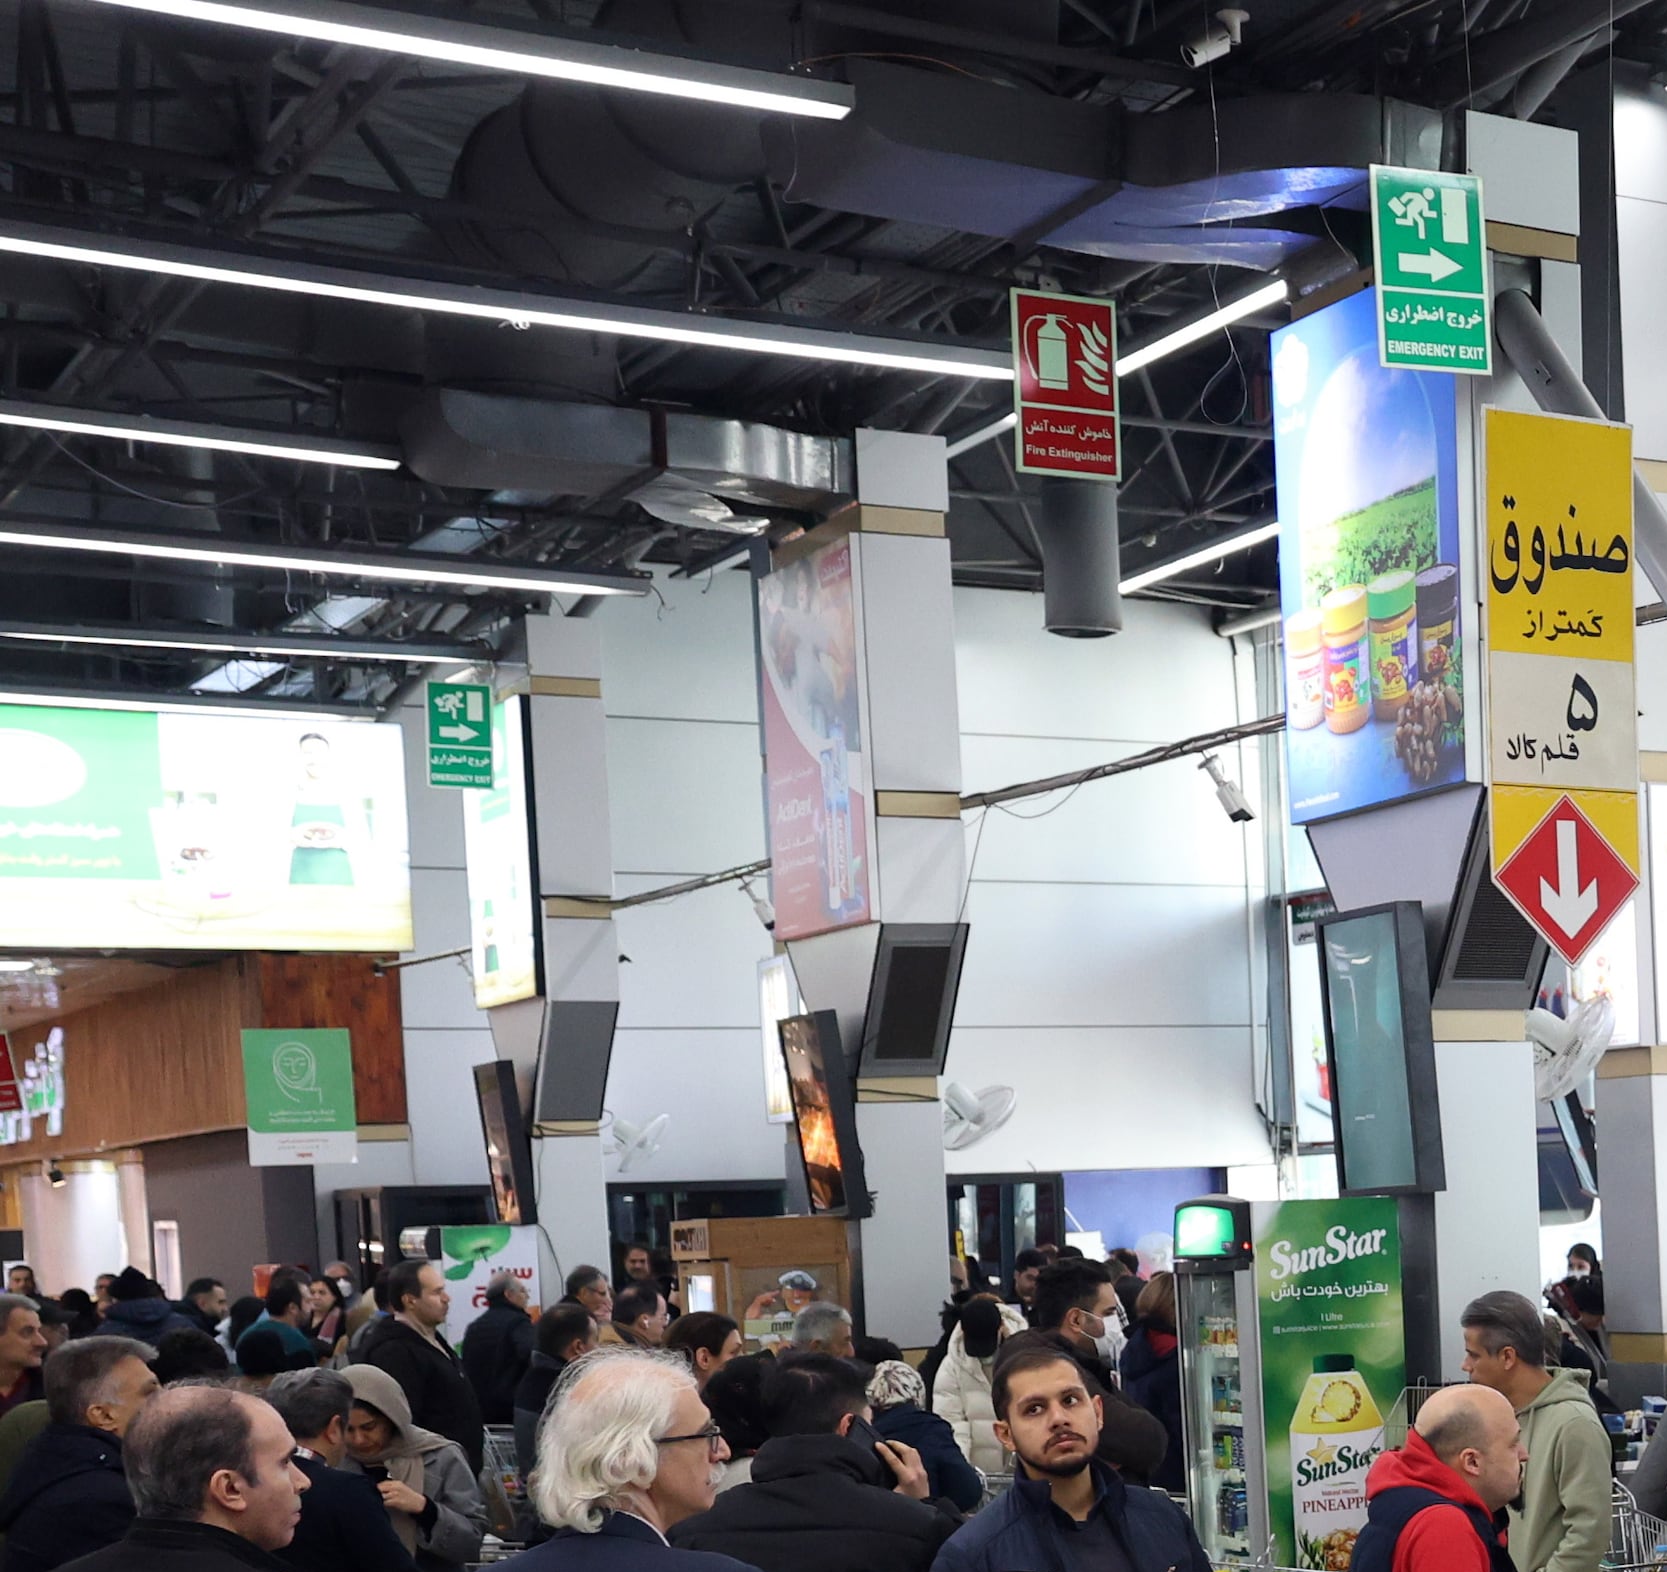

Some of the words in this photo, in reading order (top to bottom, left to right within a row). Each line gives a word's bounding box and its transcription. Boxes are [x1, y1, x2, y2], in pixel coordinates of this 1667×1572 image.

[1386, 305, 1445, 324] اضطراری
[1447, 312, 1483, 329] خروج
[1387, 340, 1456, 359] EMERGENCY
[1458, 345, 1485, 361] EXIT
[1025, 419, 1051, 438] آتش
[1050, 423, 1076, 436] کننده
[1080, 422, 1112, 441] خاموش
[1026, 445, 1046, 459] Fire
[1048, 447, 1113, 464] Extinguisher
[1490, 494, 1629, 595] صندوق
[1522, 610, 1543, 638] از
[1566, 673, 1599, 732] ۵
[1506, 733, 1537, 760] کالا
[1540, 733, 1580, 774] قلم
[1270, 1225, 1386, 1280] SunStar
[1271, 1284, 1301, 1303] باش
[1303, 1282, 1343, 1298] خودت
[1344, 1280, 1389, 1298] بهترین
